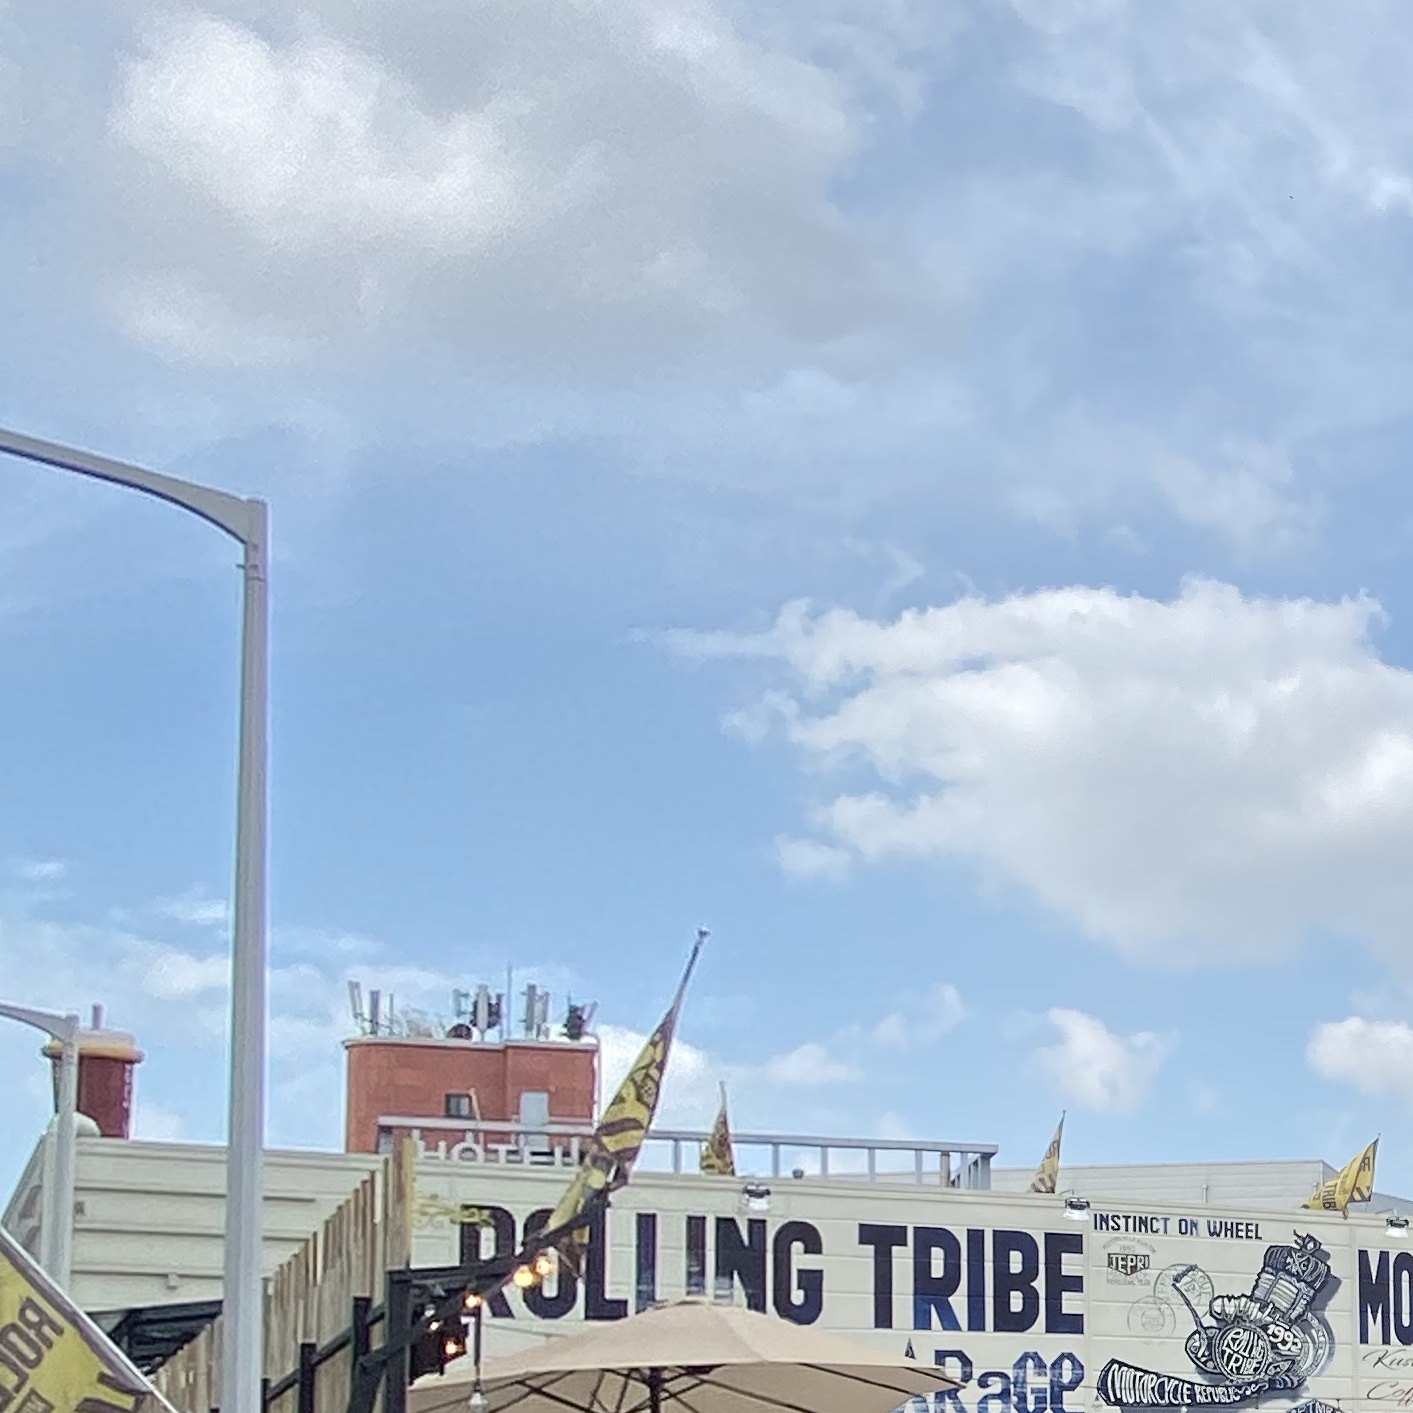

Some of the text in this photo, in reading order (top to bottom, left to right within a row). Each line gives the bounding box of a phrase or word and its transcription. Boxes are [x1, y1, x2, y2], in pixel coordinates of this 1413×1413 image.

[1322, 1182, 1338, 1211] TRIB
[1093, 1213, 1263, 1240] INSTINCT ON WHEEL
[858, 1223, 1085, 1335] TRIBE
[1267, 1323, 1302, 1352] 1992
[1107, 1363, 1192, 1404] MOTORCYCLE
